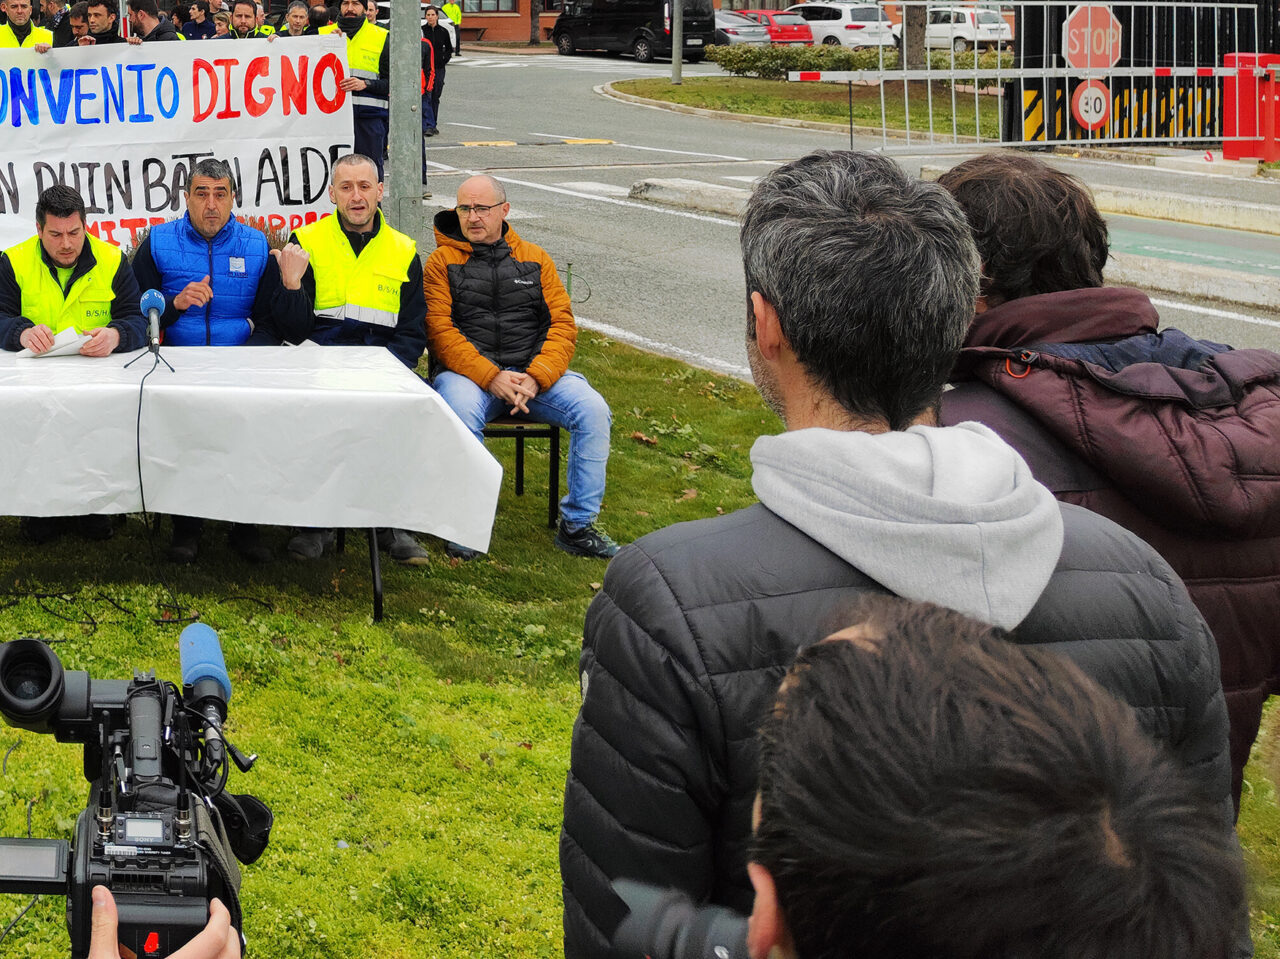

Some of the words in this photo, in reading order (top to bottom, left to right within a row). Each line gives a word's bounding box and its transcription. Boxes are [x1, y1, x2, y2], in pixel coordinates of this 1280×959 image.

[1068, 28, 1118, 56] STOP
[192, 53, 347, 123] DIGNO
[142, 151, 243, 213] BATN
